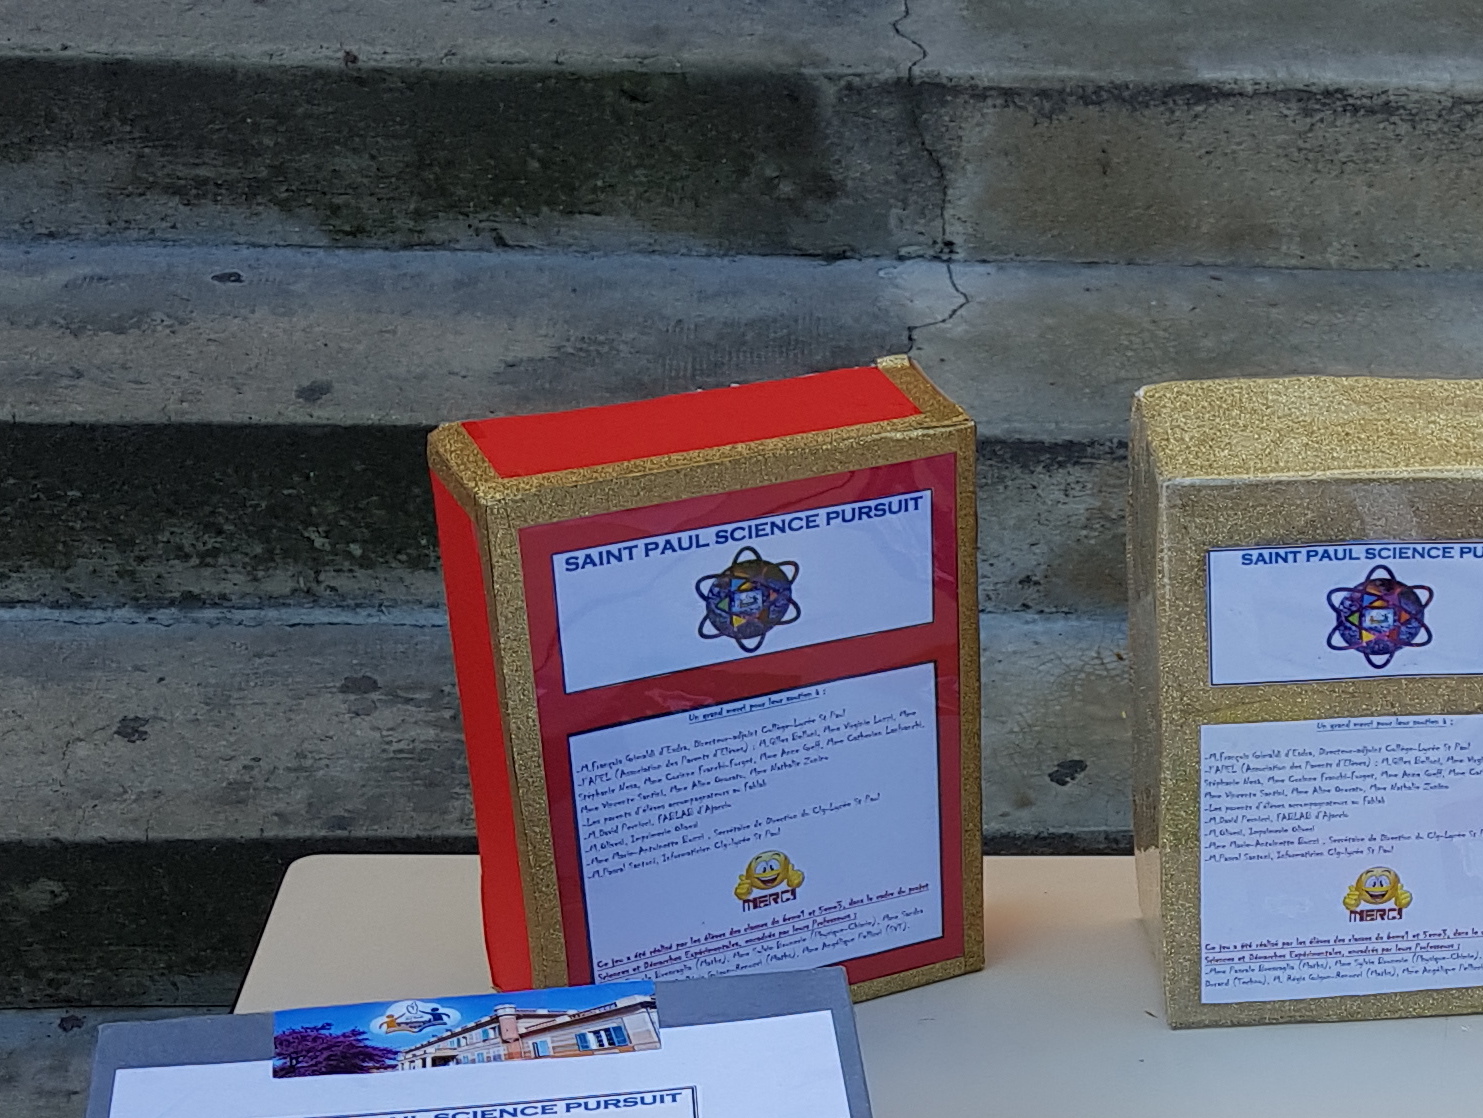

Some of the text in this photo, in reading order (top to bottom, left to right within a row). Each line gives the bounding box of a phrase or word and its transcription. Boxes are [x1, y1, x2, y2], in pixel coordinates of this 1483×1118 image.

[565, 496, 922, 572] SAINT PAUL SCIENCE PURSUIT
[1240, 549, 1302, 566] SAINT
[1305, 547, 1361, 562] PAUL
[1364, 545, 1454, 560] SCIENCE
[1349, 907, 1403, 922] MERCI
[565, 1092, 681, 1113] PURSUIT
